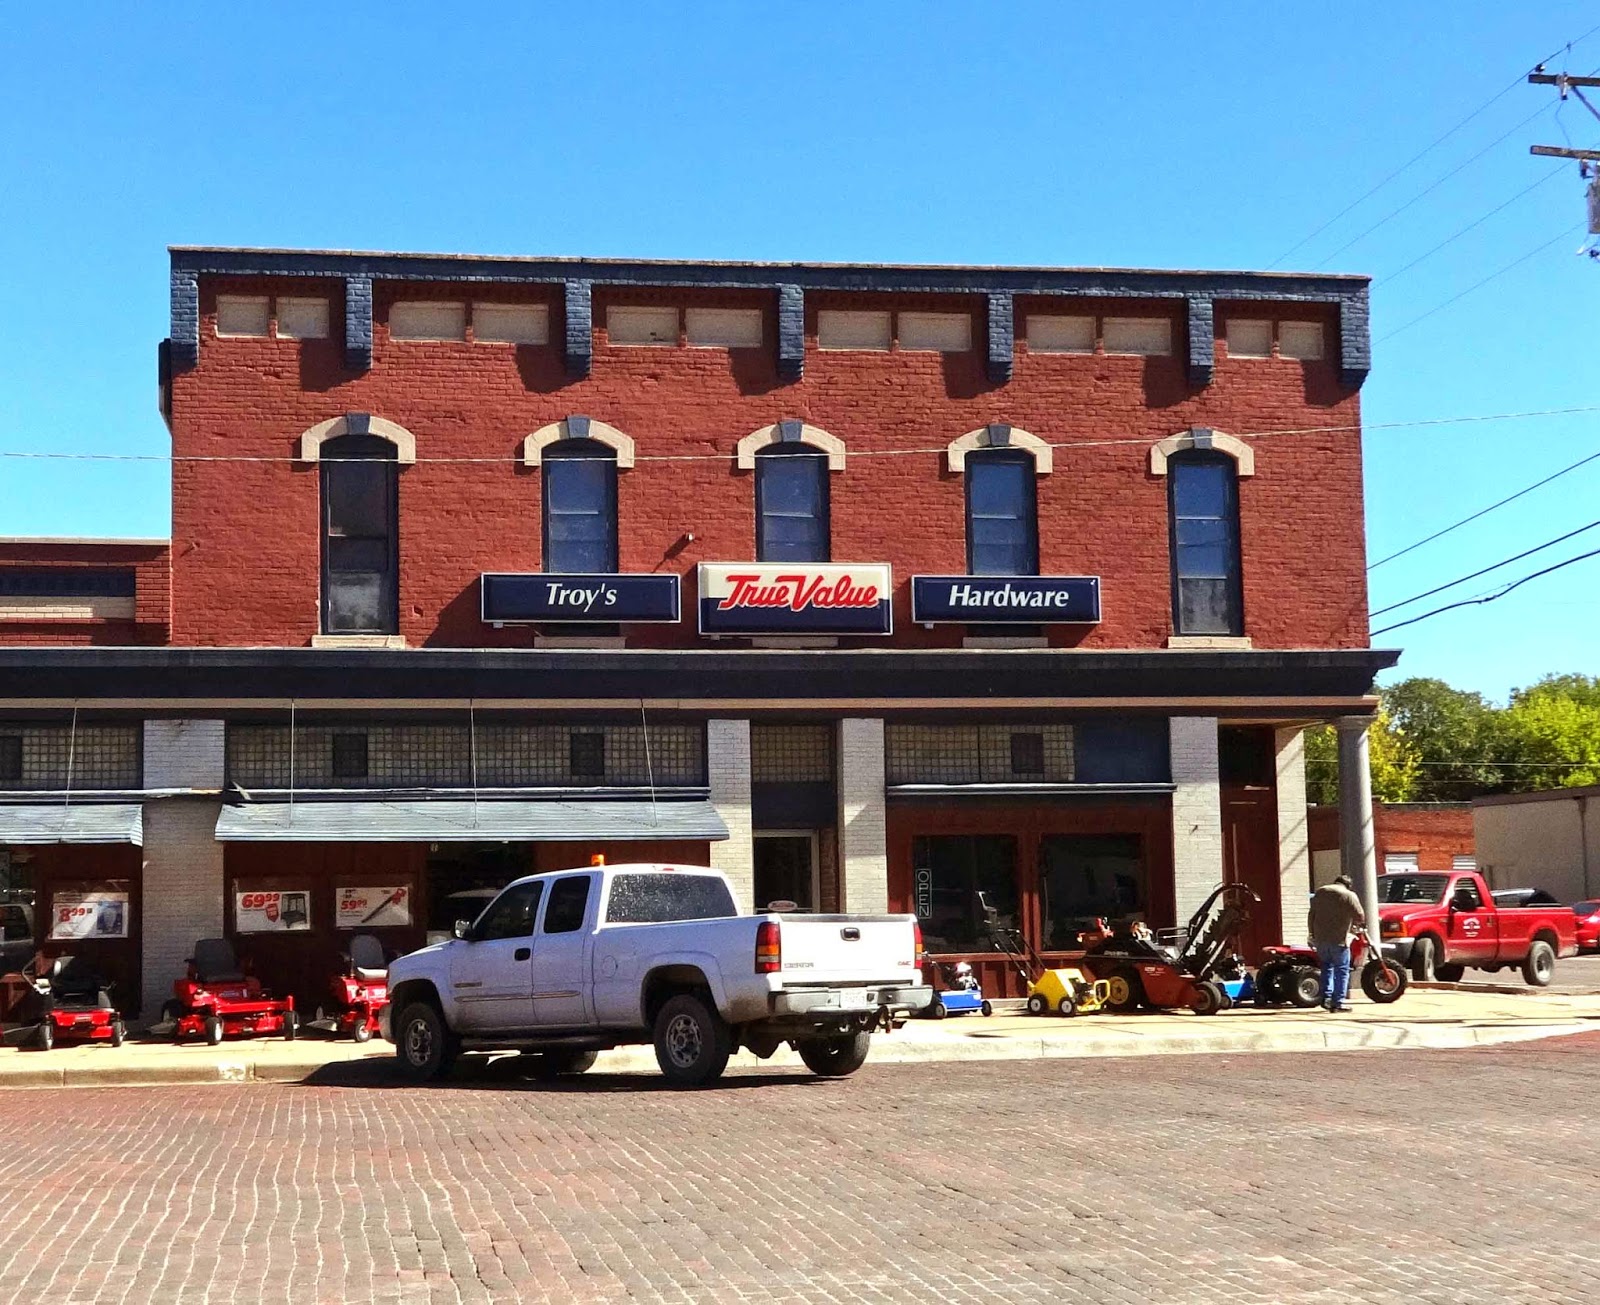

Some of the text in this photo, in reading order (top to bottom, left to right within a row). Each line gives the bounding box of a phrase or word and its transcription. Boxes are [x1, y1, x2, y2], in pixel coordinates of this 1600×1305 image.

[546, 583, 617, 612] Troy's
[717, 574, 880, 612] True Value
[949, 584, 1070, 608] Hardware
[917, 870, 931, 917] OPEN
